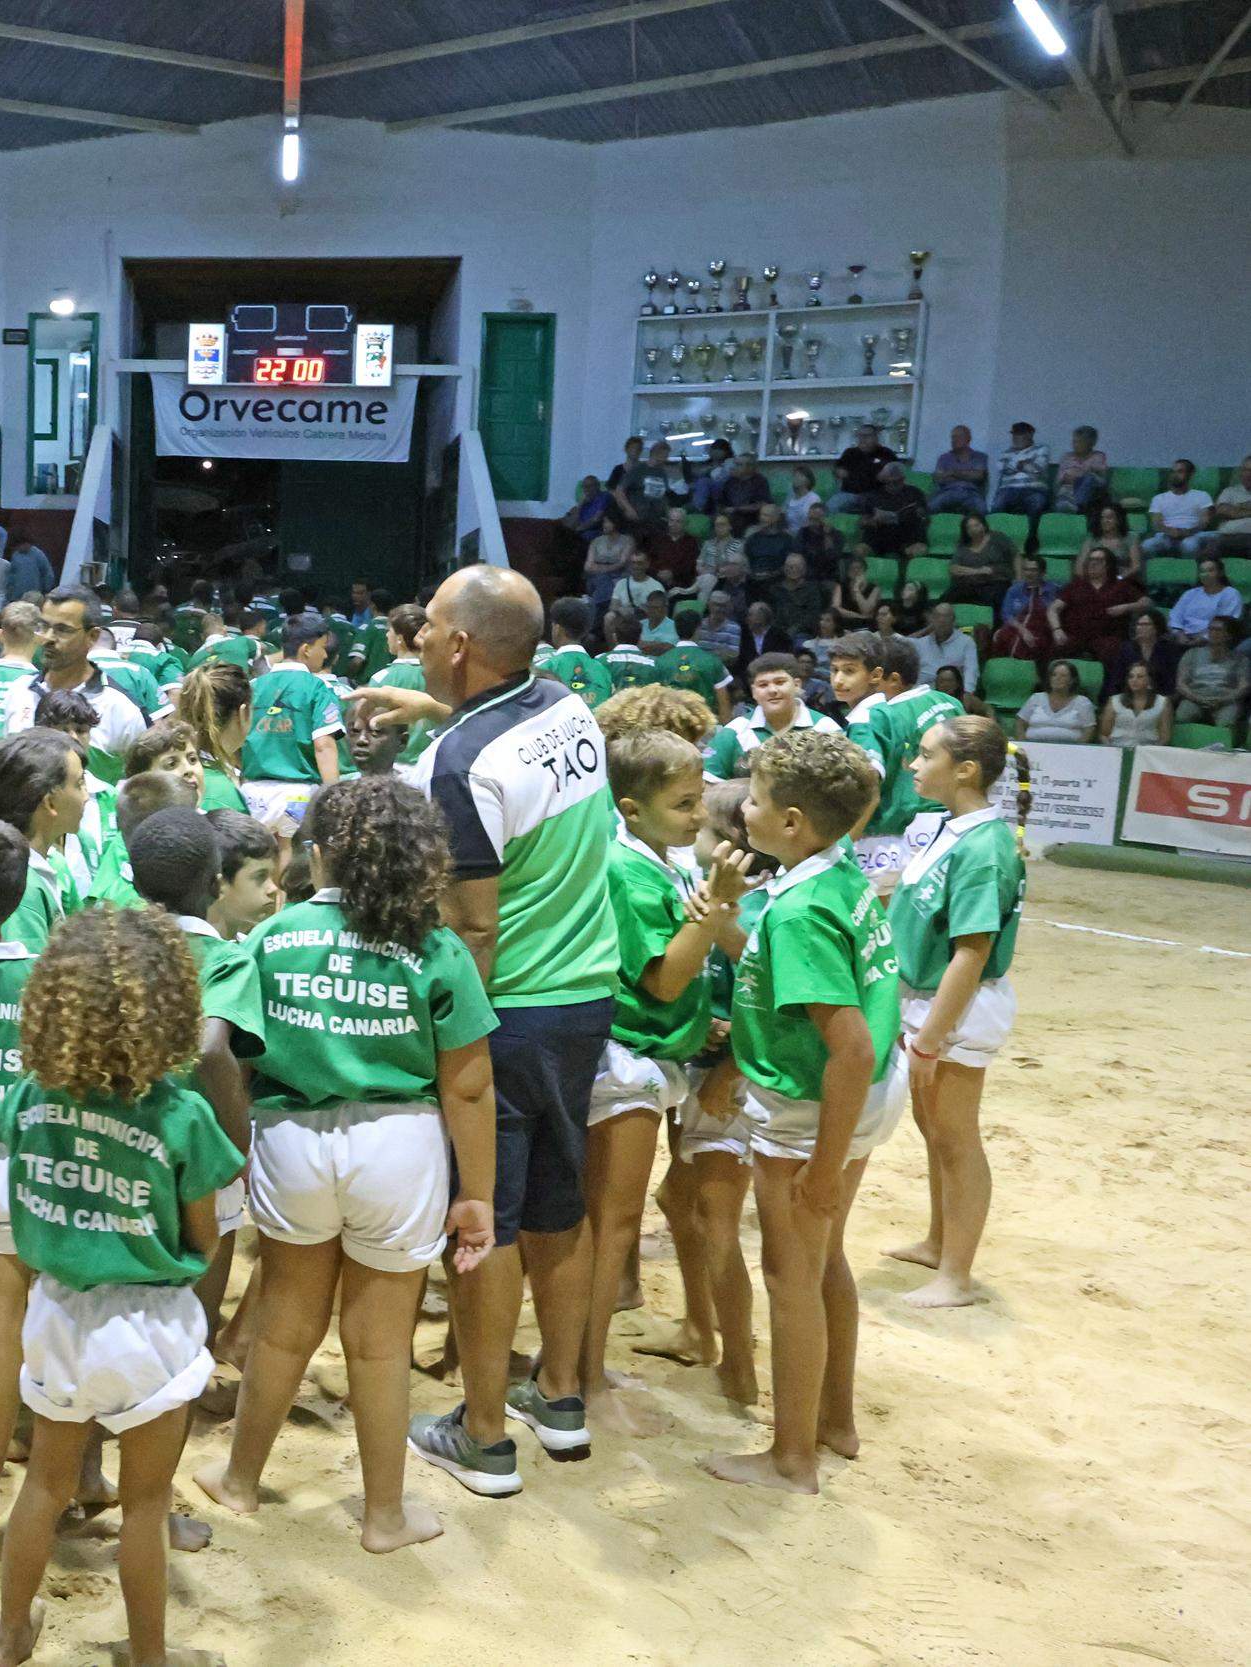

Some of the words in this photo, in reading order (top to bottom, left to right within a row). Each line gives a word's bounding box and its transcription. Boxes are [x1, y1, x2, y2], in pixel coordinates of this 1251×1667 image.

[256, 359, 287, 382] 22
[292, 359, 324, 382] 00
[178, 390, 389, 425] Orvecame
[518, 738, 550, 765] CLUB
[545, 729, 565, 749] DE
[559, 716, 592, 741] LUCH
[542, 738, 598, 793] TAO
[263, 929, 334, 954] ESCUELA
[328, 953, 353, 974] DE
[273, 972, 409, 1010] TEGUISE
[267, 1000, 325, 1031] LUCHA
[329, 1015, 420, 1037] CANARIA
[74, 1136, 100, 1161] DE
[18, 1152, 151, 1208] TEGUISE
[15, 1182, 68, 1226] LUCHA
